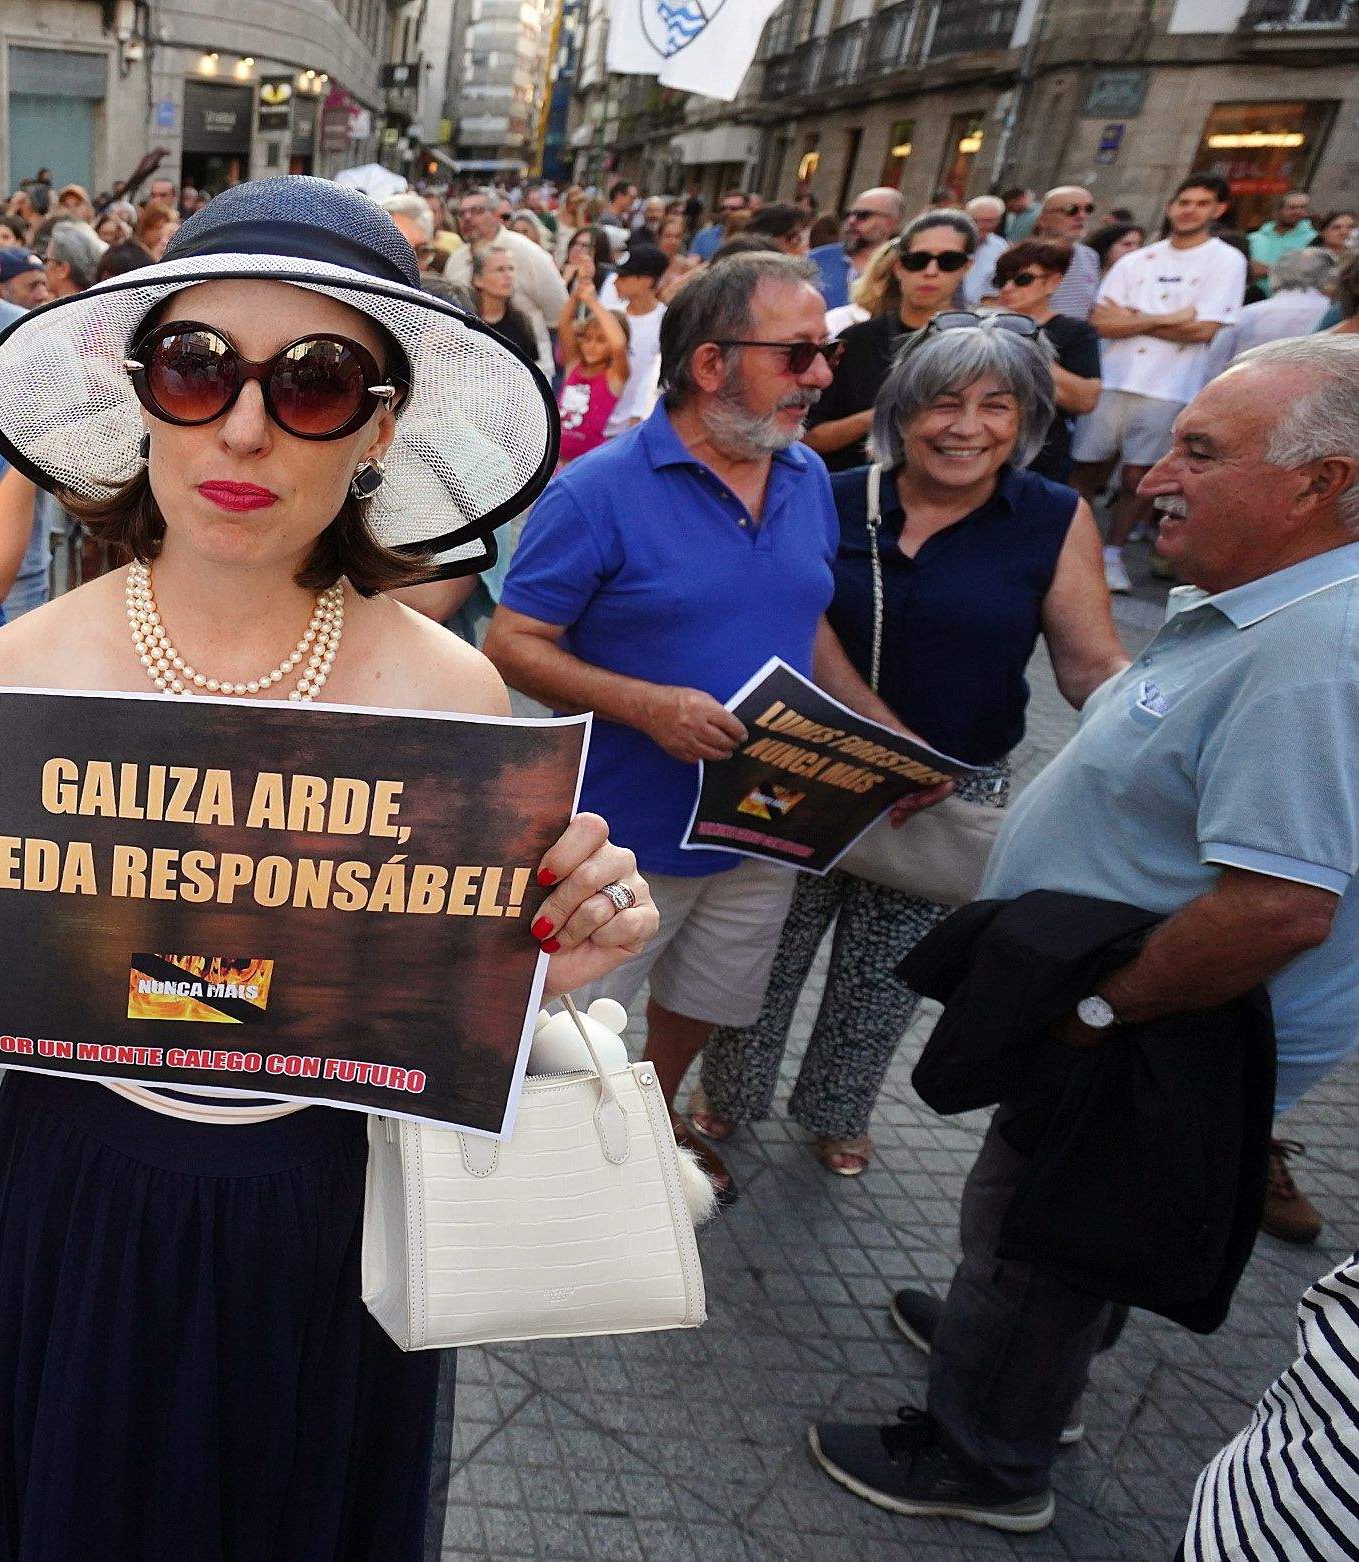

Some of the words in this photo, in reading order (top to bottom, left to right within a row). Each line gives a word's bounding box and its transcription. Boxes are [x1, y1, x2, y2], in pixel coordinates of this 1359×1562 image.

[42, 757, 235, 826] GALIZA
[245, 772, 411, 845] ARDE,
[111, 844, 531, 918] RESPONSÁBEL!
[138, 980, 203, 998] NUNCA
[207, 983, 259, 1000] MAIS
[38, 1039, 72, 1059] UN
[77, 1044, 162, 1066] MONTE
[166, 1049, 261, 1073] GALEGO
[265, 1055, 320, 1078] CON
[324, 1059, 427, 1094] FUTURO
